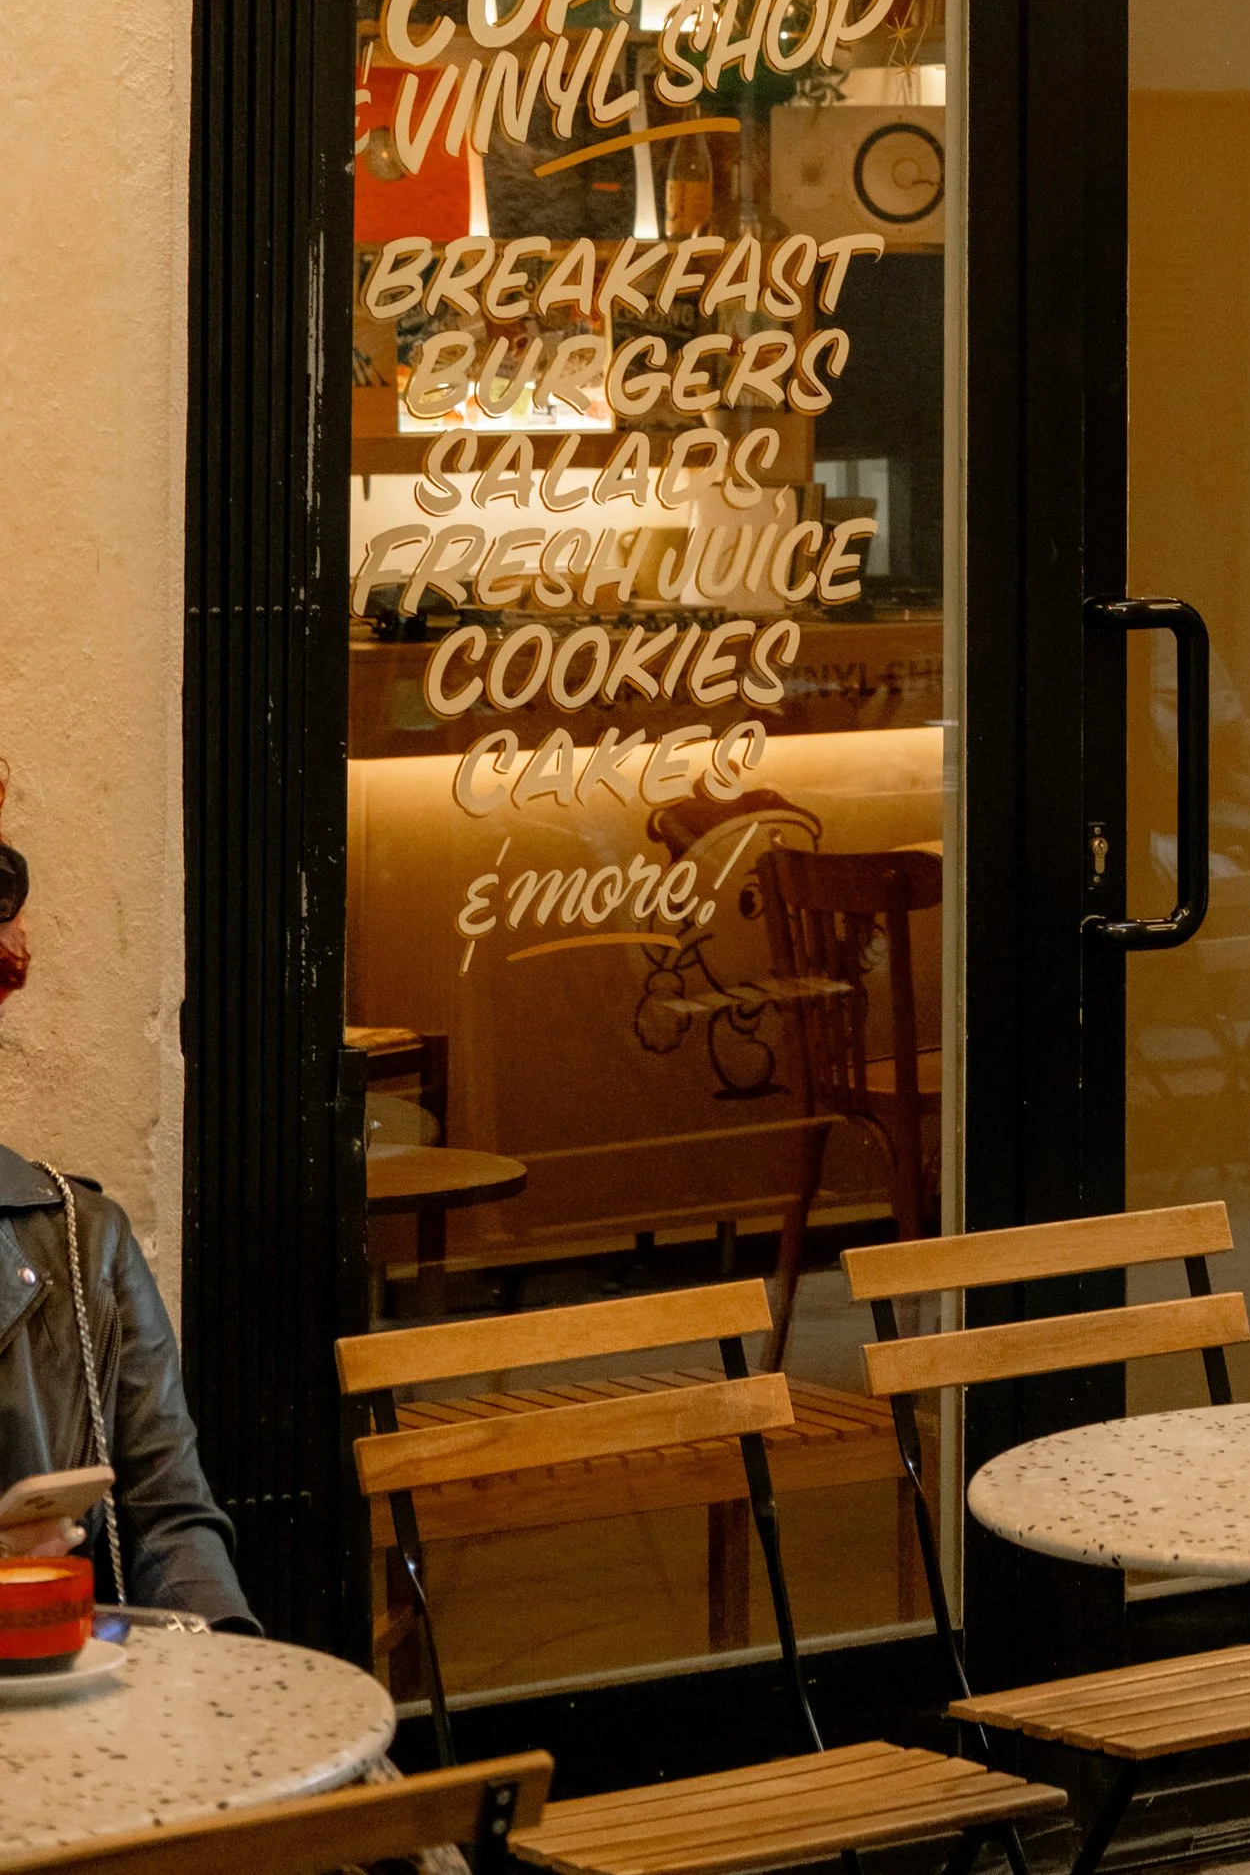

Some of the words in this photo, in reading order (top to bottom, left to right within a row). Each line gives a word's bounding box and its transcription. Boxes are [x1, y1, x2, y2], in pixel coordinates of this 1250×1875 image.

[392, 19, 640, 176] VINYL
[363, 232, 885, 321] BREAKFAST
[404, 327, 850, 420] BURGERS
[414, 427, 781, 517] SALADS
[349, 522, 652, 618] FRESH
[656, 517, 879, 606] JUICE
[423, 618, 801, 720] COOKIES
[451, 719, 767, 819] CAKES
